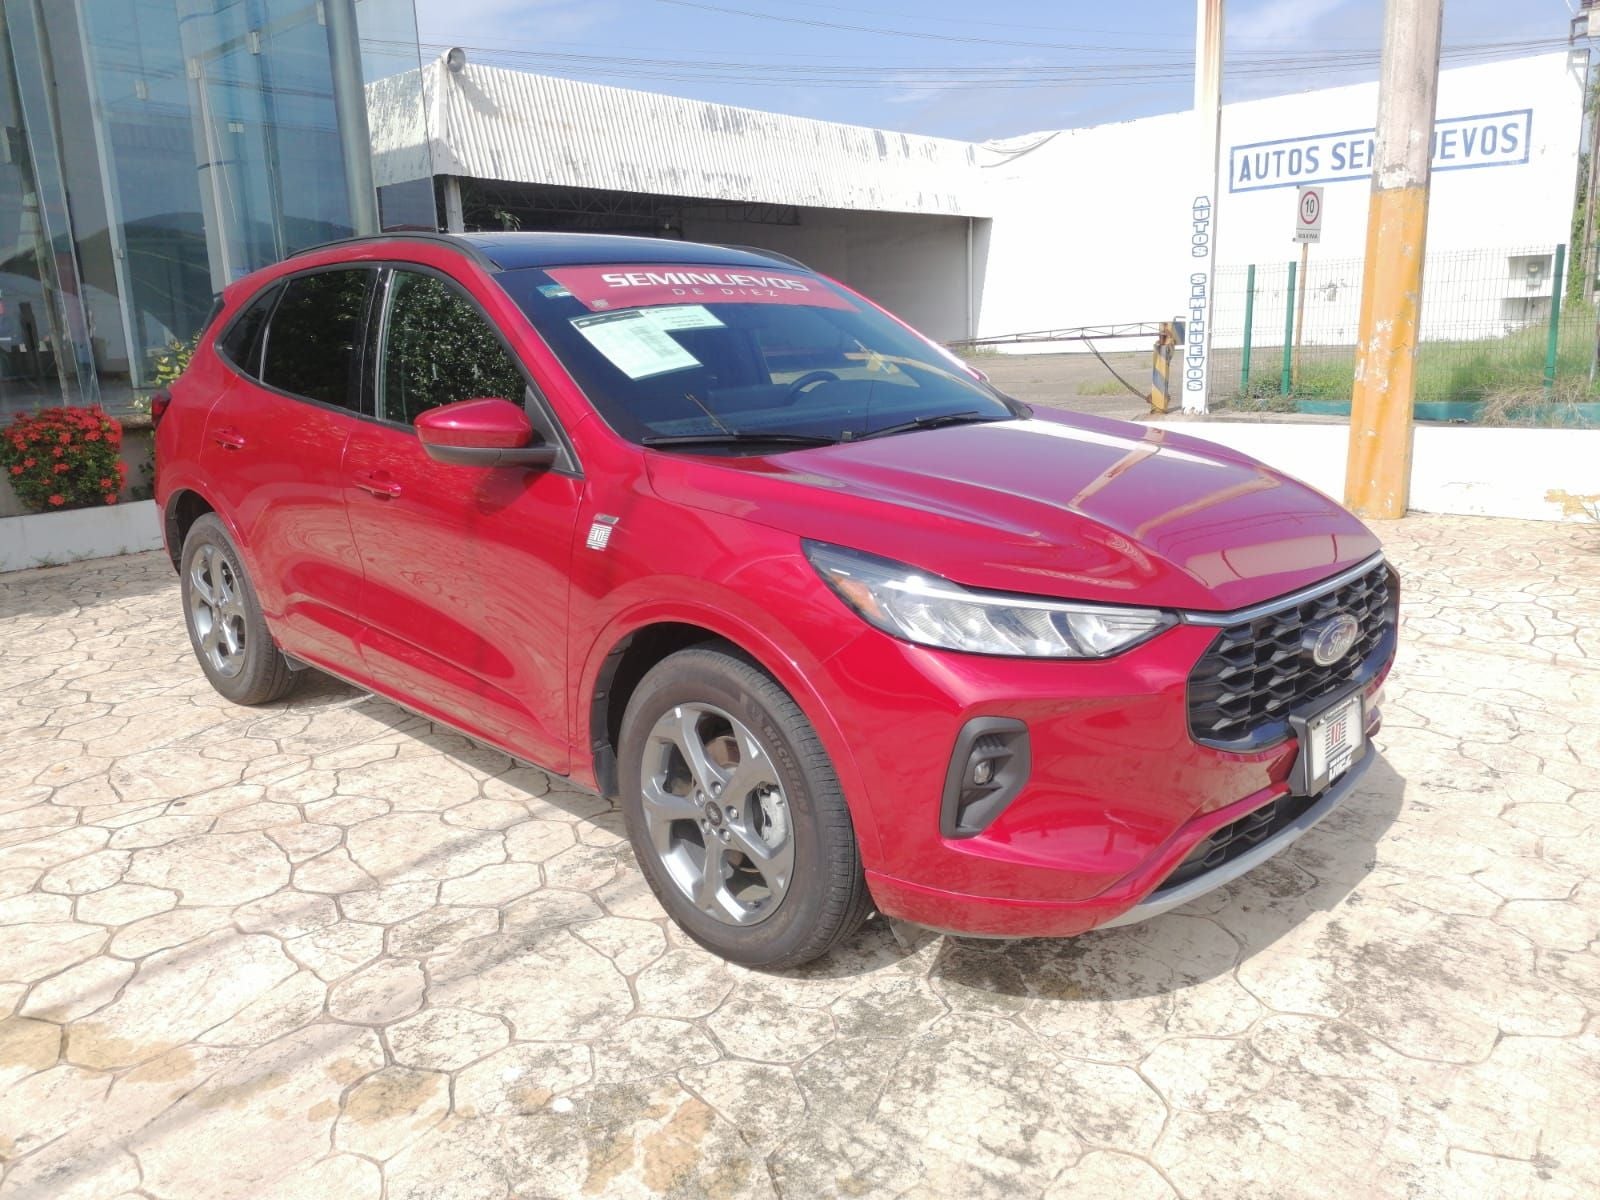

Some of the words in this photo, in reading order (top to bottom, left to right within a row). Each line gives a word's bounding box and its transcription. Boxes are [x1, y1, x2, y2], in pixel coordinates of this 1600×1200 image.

[1238, 146, 1321, 183] AUTOS
[1331, 122, 1520, 171] SEEVOS
[1306, 199, 1315, 214] 10
[1192, 196, 1211, 258] AUTOS
[600, 272, 810, 292] SEMINUEVOS
[671, 288, 705, 296] DE
[720, 288, 779, 297] DIEZ
[1187, 273, 1207, 391] SEMINUEVOS
